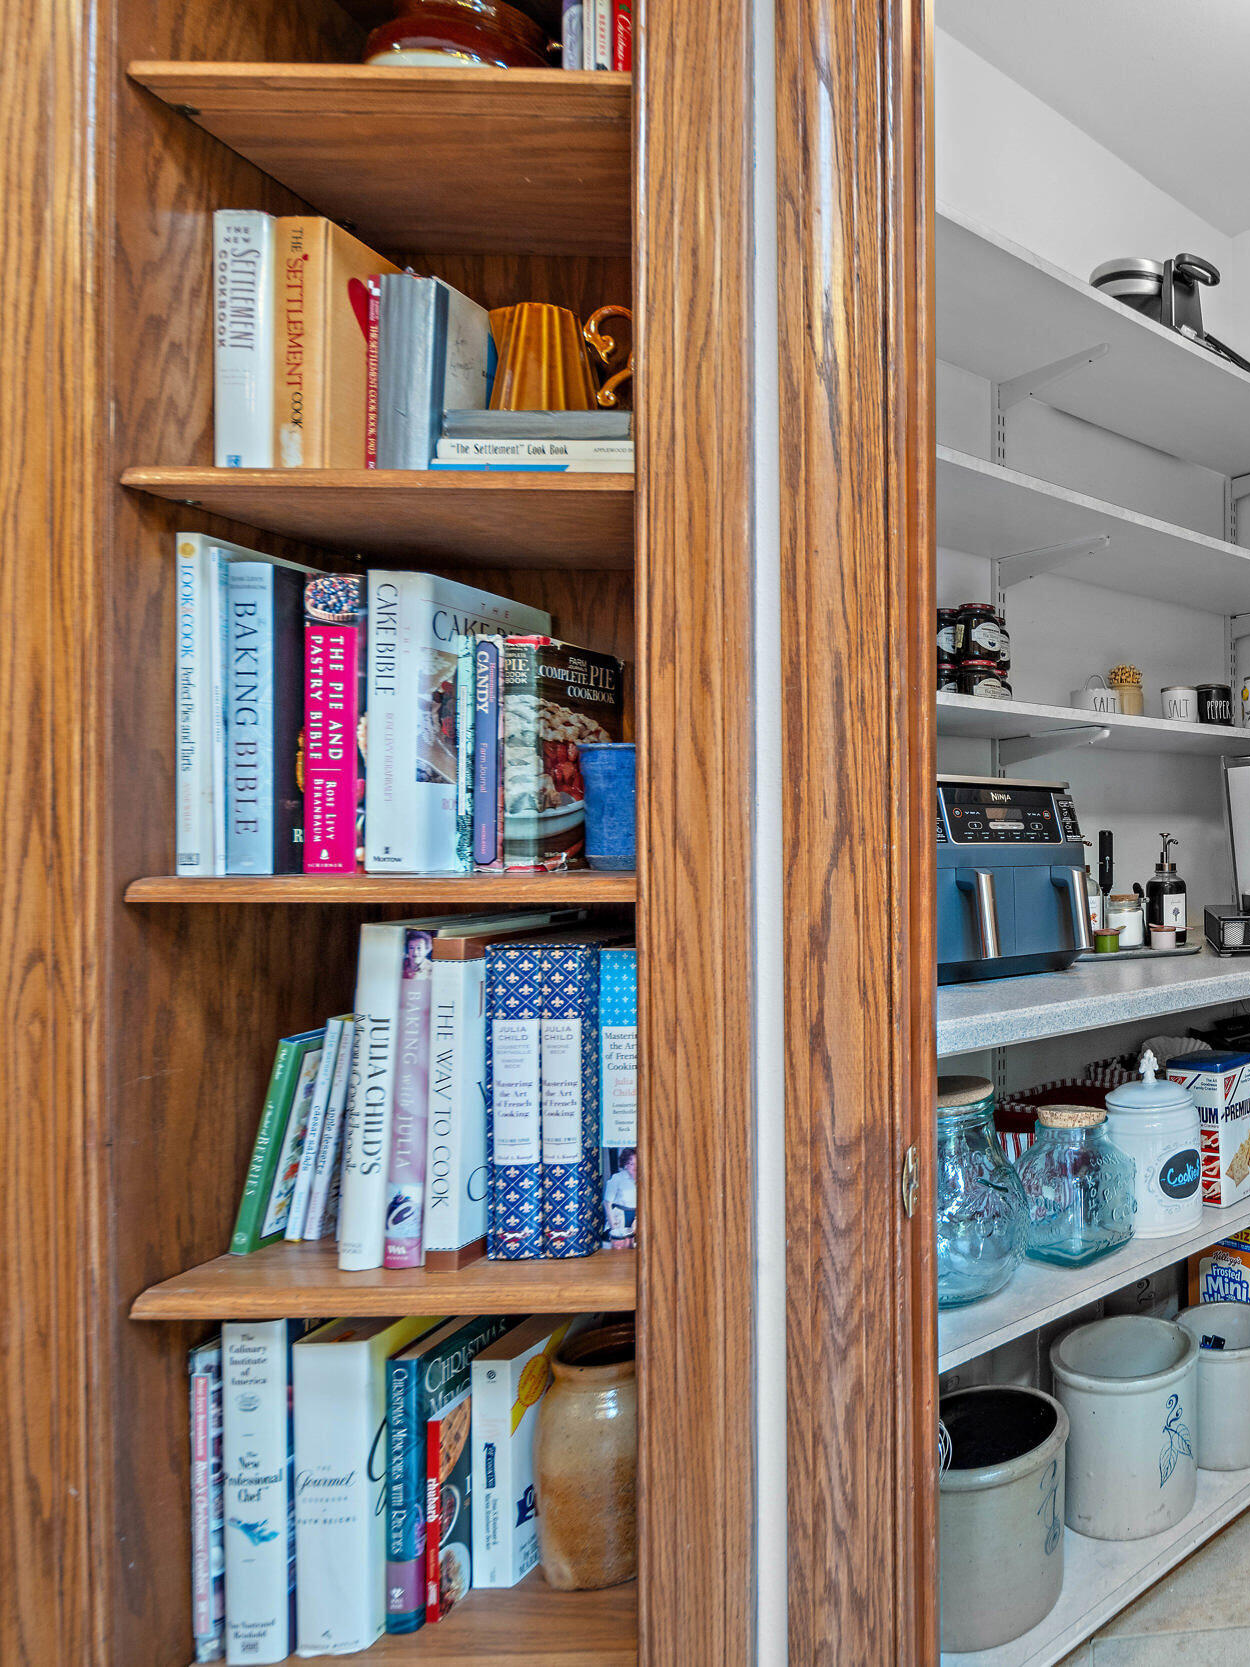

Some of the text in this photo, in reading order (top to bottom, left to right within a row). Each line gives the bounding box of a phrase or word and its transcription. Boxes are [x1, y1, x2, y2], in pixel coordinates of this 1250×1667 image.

[218, 250, 228, 348] COOKBOOK
[230, 249, 260, 351] SETTLEMENT
[286, 228, 306, 429] THE SETTLEMENT COOK
[368, 340, 378, 388] SETTLEMENT
[368, 389, 377, 410] COOK
[527, 444, 546, 455] Cook
[550, 445, 568, 456] Book
[432, 610, 490, 642] CAKE
[375, 584, 398, 696] CAKE BIBLE
[234, 602, 258, 727] BAKING
[504, 659, 530, 672] PIE
[540, 665, 615, 690] COMPLETE PIE
[180, 666, 196, 700] Perfect
[568, 686, 615, 704] COOKBOOK
[310, 635, 323, 759] PASTRY BIBLE
[328, 636, 344, 760] THE PIE AND
[1168, 699, 1190, 719] SALT
[1207, 700, 1231, 719] PEPPER
[181, 724, 195, 744] and
[476, 650, 490, 793] CANDY Farm Journal
[234, 742, 259, 835] BIBLE
[990, 792, 1011, 803] NINJA
[402, 990, 422, 1064] BAKING
[610, 1042, 622, 1050] the
[360, 1014, 391, 1176] JULIA CHILD'S
[431, 1000, 455, 1209] THE WAY TO COOK
[309, 1105, 322, 1137] caesar
[396, 1113, 414, 1169] JULIA
[246, 1136, 270, 1196] BERRIES
[1213, 1251, 1242, 1265] Kellogg's
[1212, 1264, 1241, 1282] Frosted
[1206, 1274, 1249, 1300] Mini
[229, 1344, 267, 1354] Culinary
[229, 1357, 268, 1365] Institute
[231, 1377, 267, 1386] America
[240, 1368, 251, 1376] of
[238, 1458, 260, 1469] New
[296, 1471, 356, 1492] Gourmet
[238, 1488, 262, 1502] Chef
[426, 1478, 438, 1523] rhubarb
